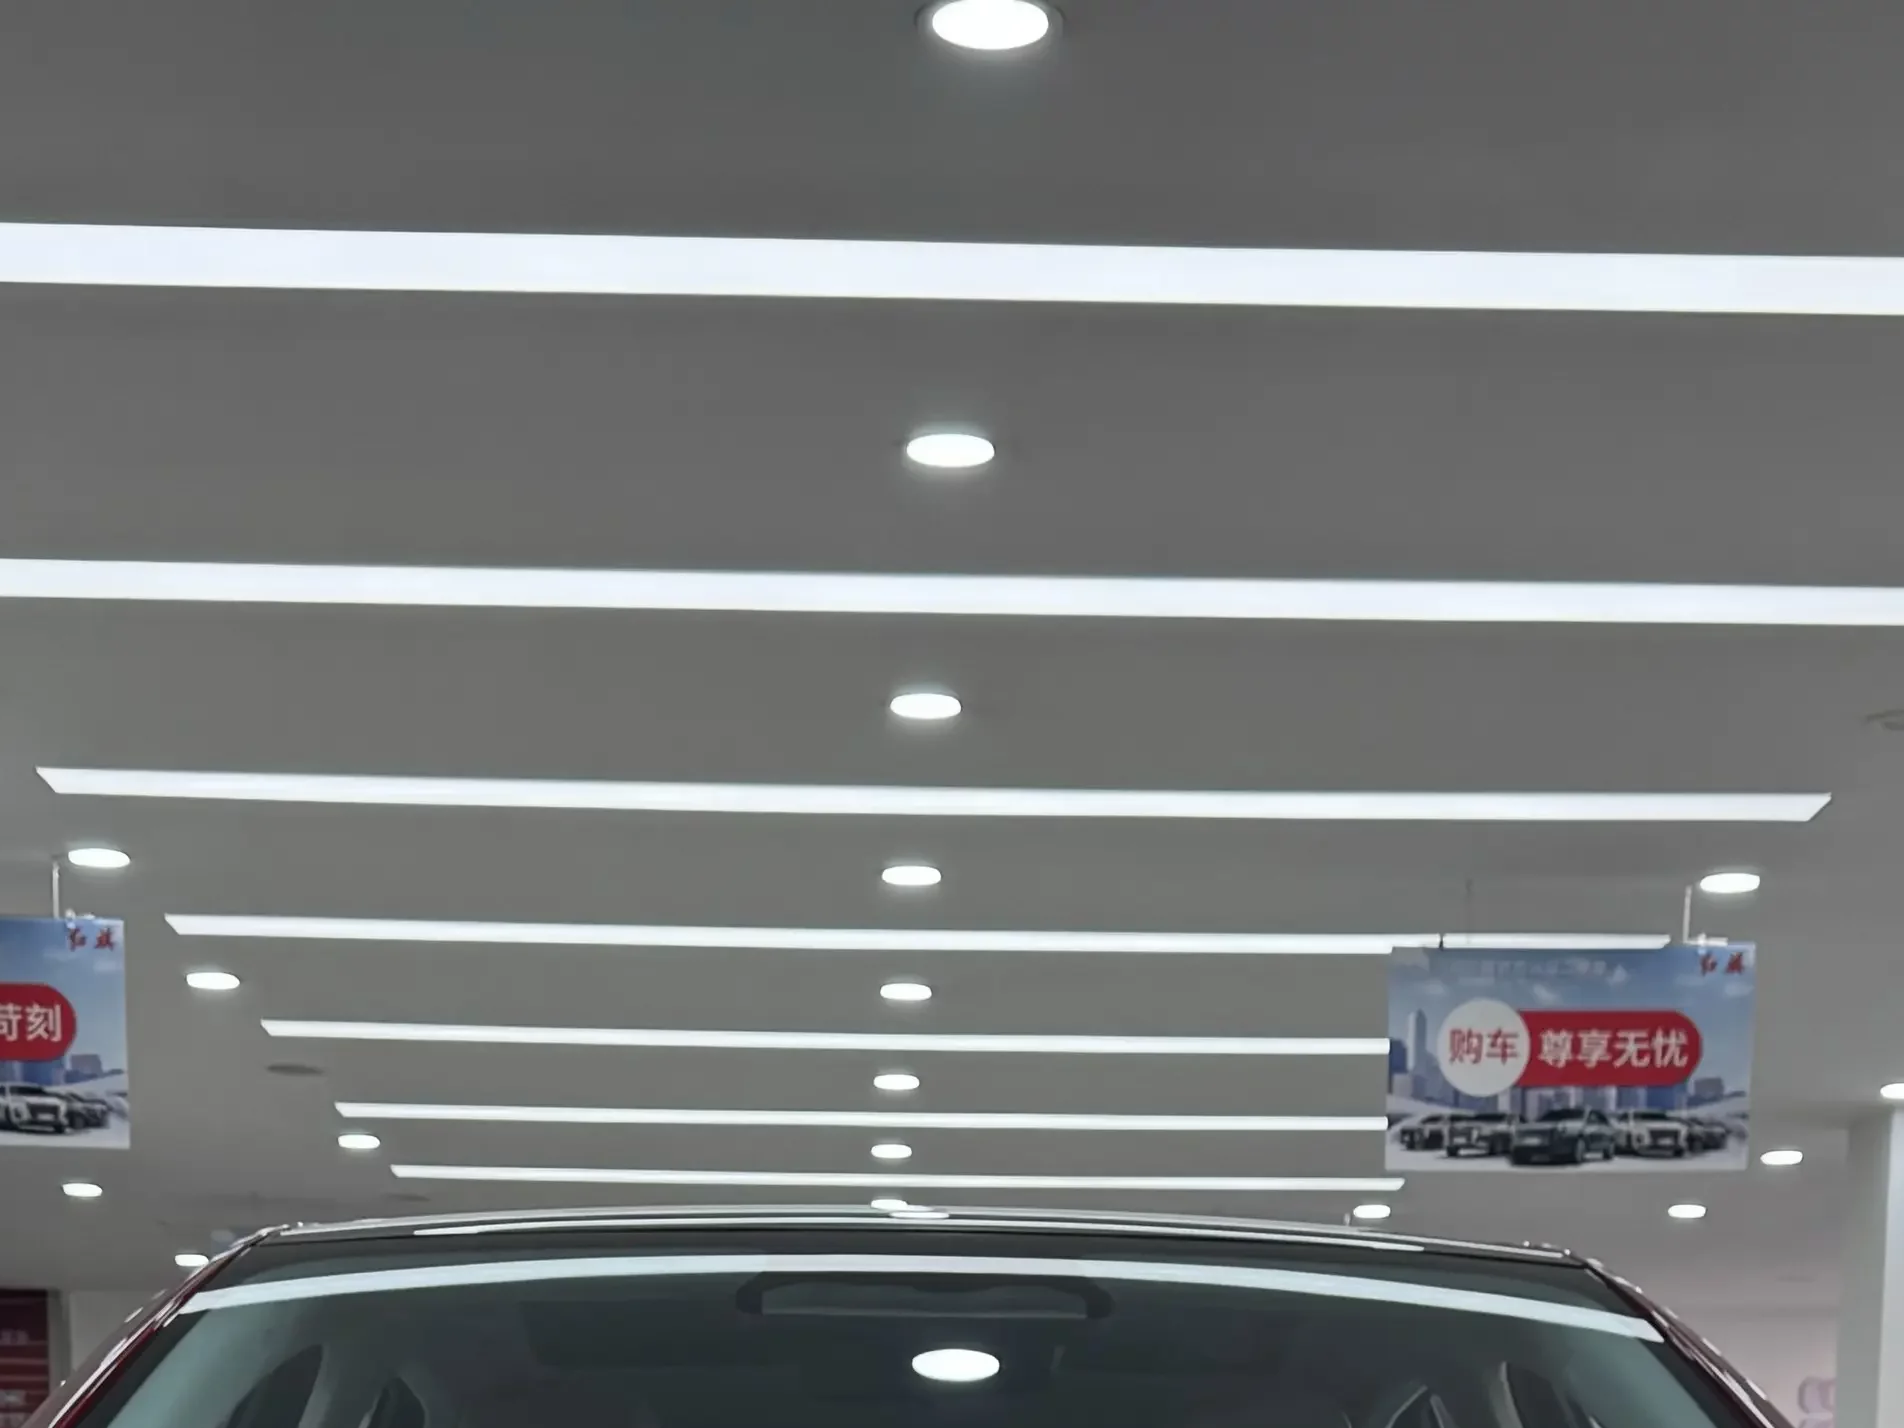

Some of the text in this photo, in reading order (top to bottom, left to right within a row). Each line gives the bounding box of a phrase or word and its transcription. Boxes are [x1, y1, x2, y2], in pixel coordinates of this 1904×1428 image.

[1448, 1028, 1689, 1069] 购车 尊享无忧
